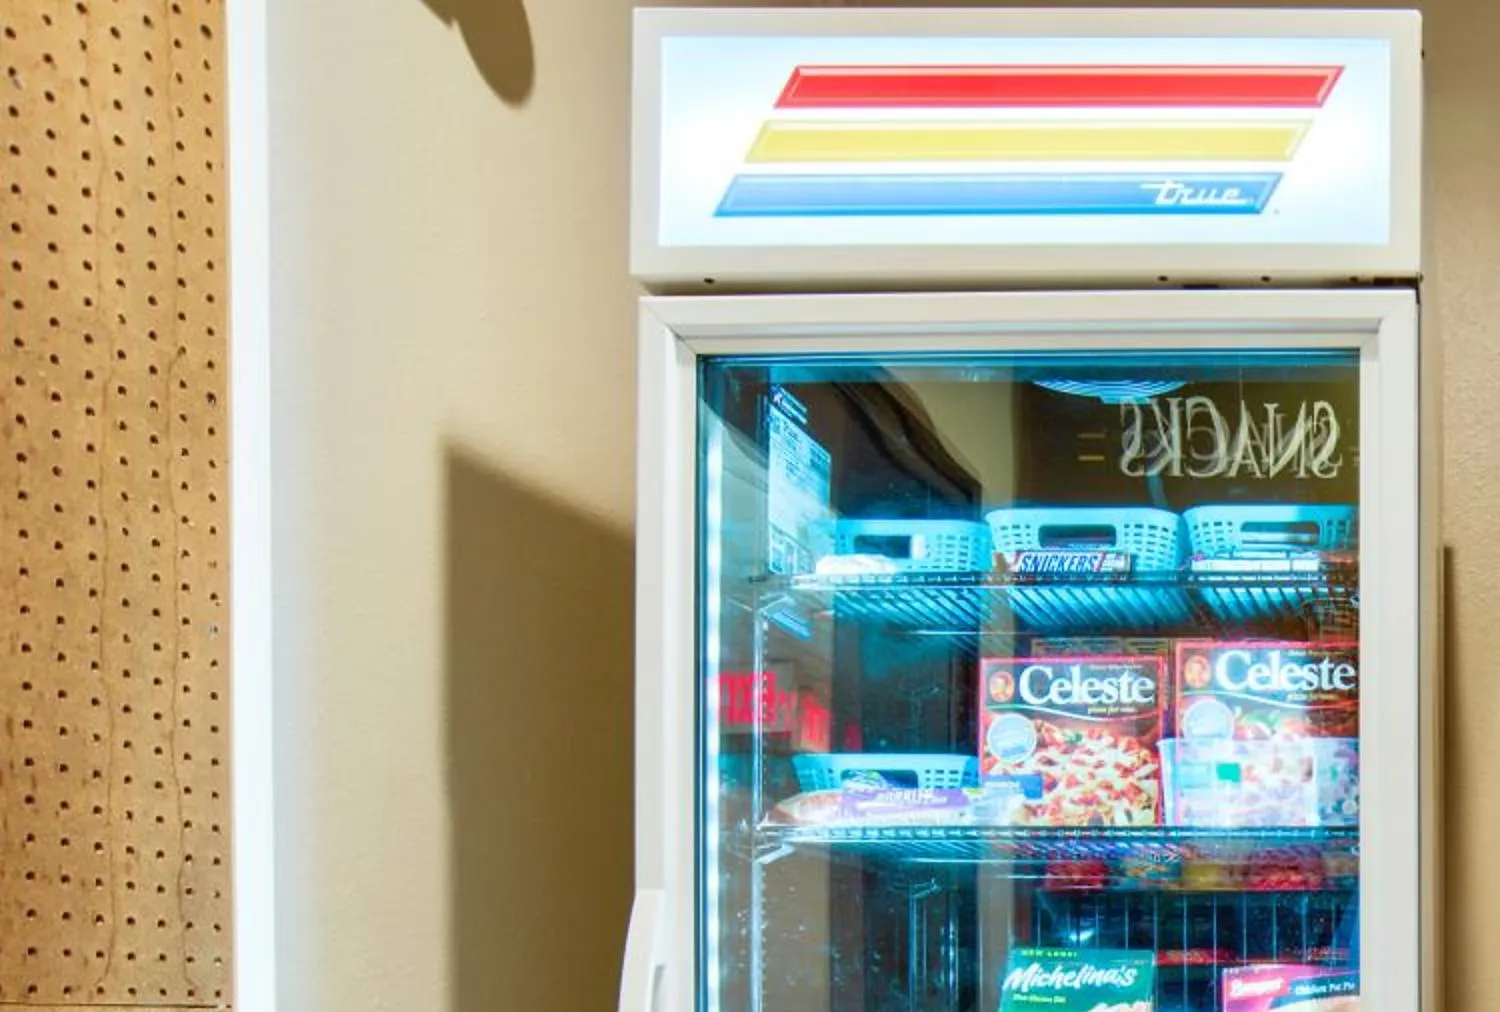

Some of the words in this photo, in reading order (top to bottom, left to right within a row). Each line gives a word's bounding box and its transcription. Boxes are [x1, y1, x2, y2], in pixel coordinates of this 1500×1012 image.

[1020, 554, 1098, 573] SNICKERS
[1019, 664, 1155, 704] Celeste
[1215, 650, 1356, 691] Celeste
[1002, 962, 1138, 993] Michelina's
